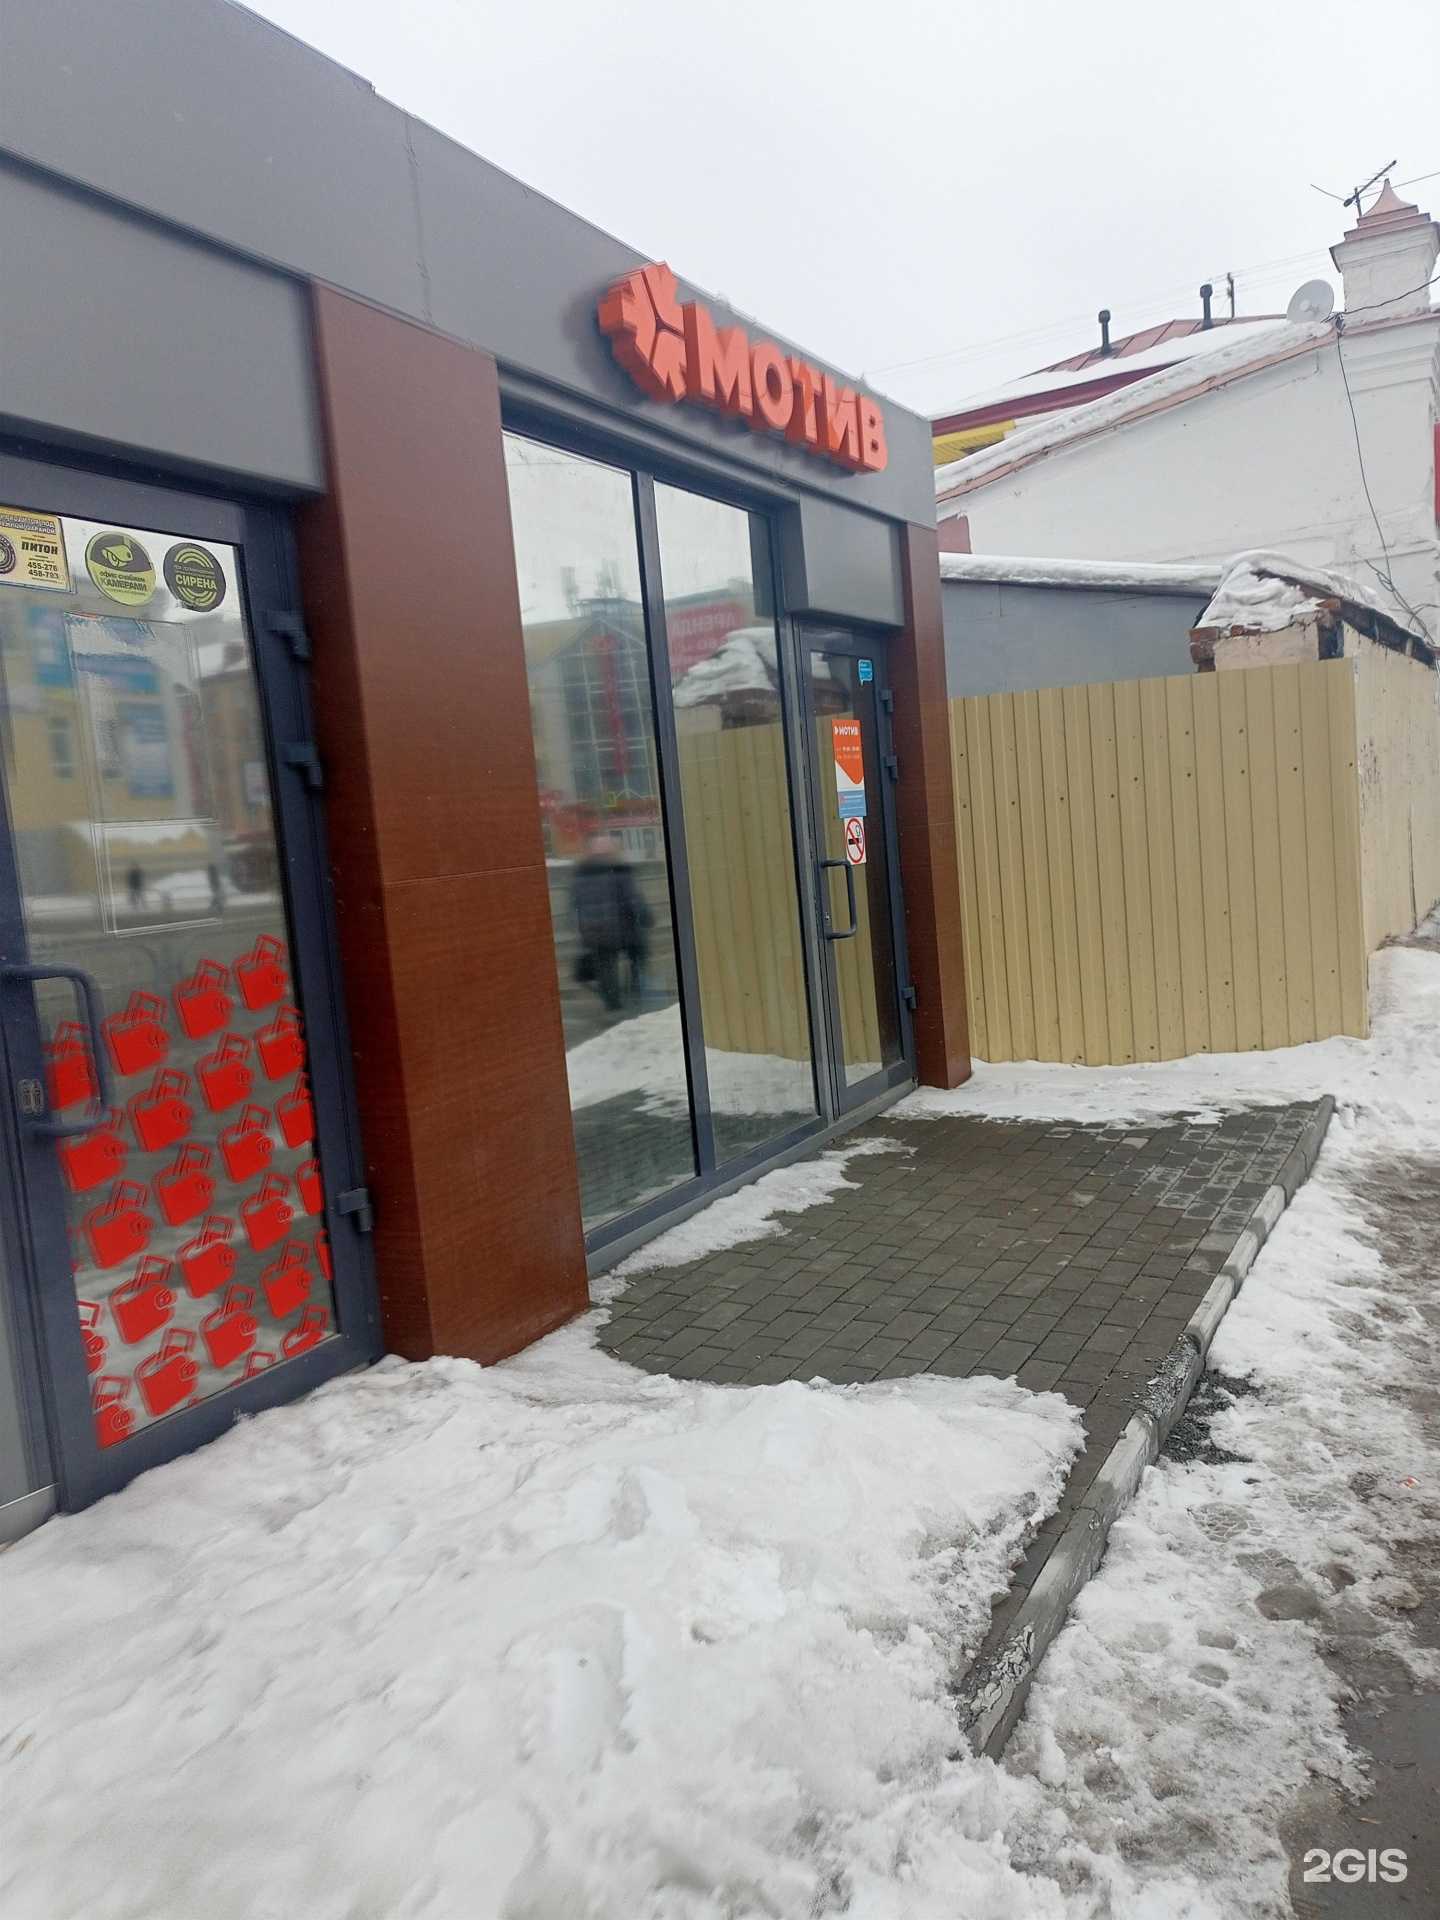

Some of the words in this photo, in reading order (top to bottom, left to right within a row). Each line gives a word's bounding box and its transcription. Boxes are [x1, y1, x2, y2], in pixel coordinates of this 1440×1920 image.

[685, 301, 887, 473] МОТИВ
[21, 541, 58, 555] ПИТОН
[101, 577, 147, 592] КАМЕРАМИ
[175, 574, 217, 590] СИРЕНА
